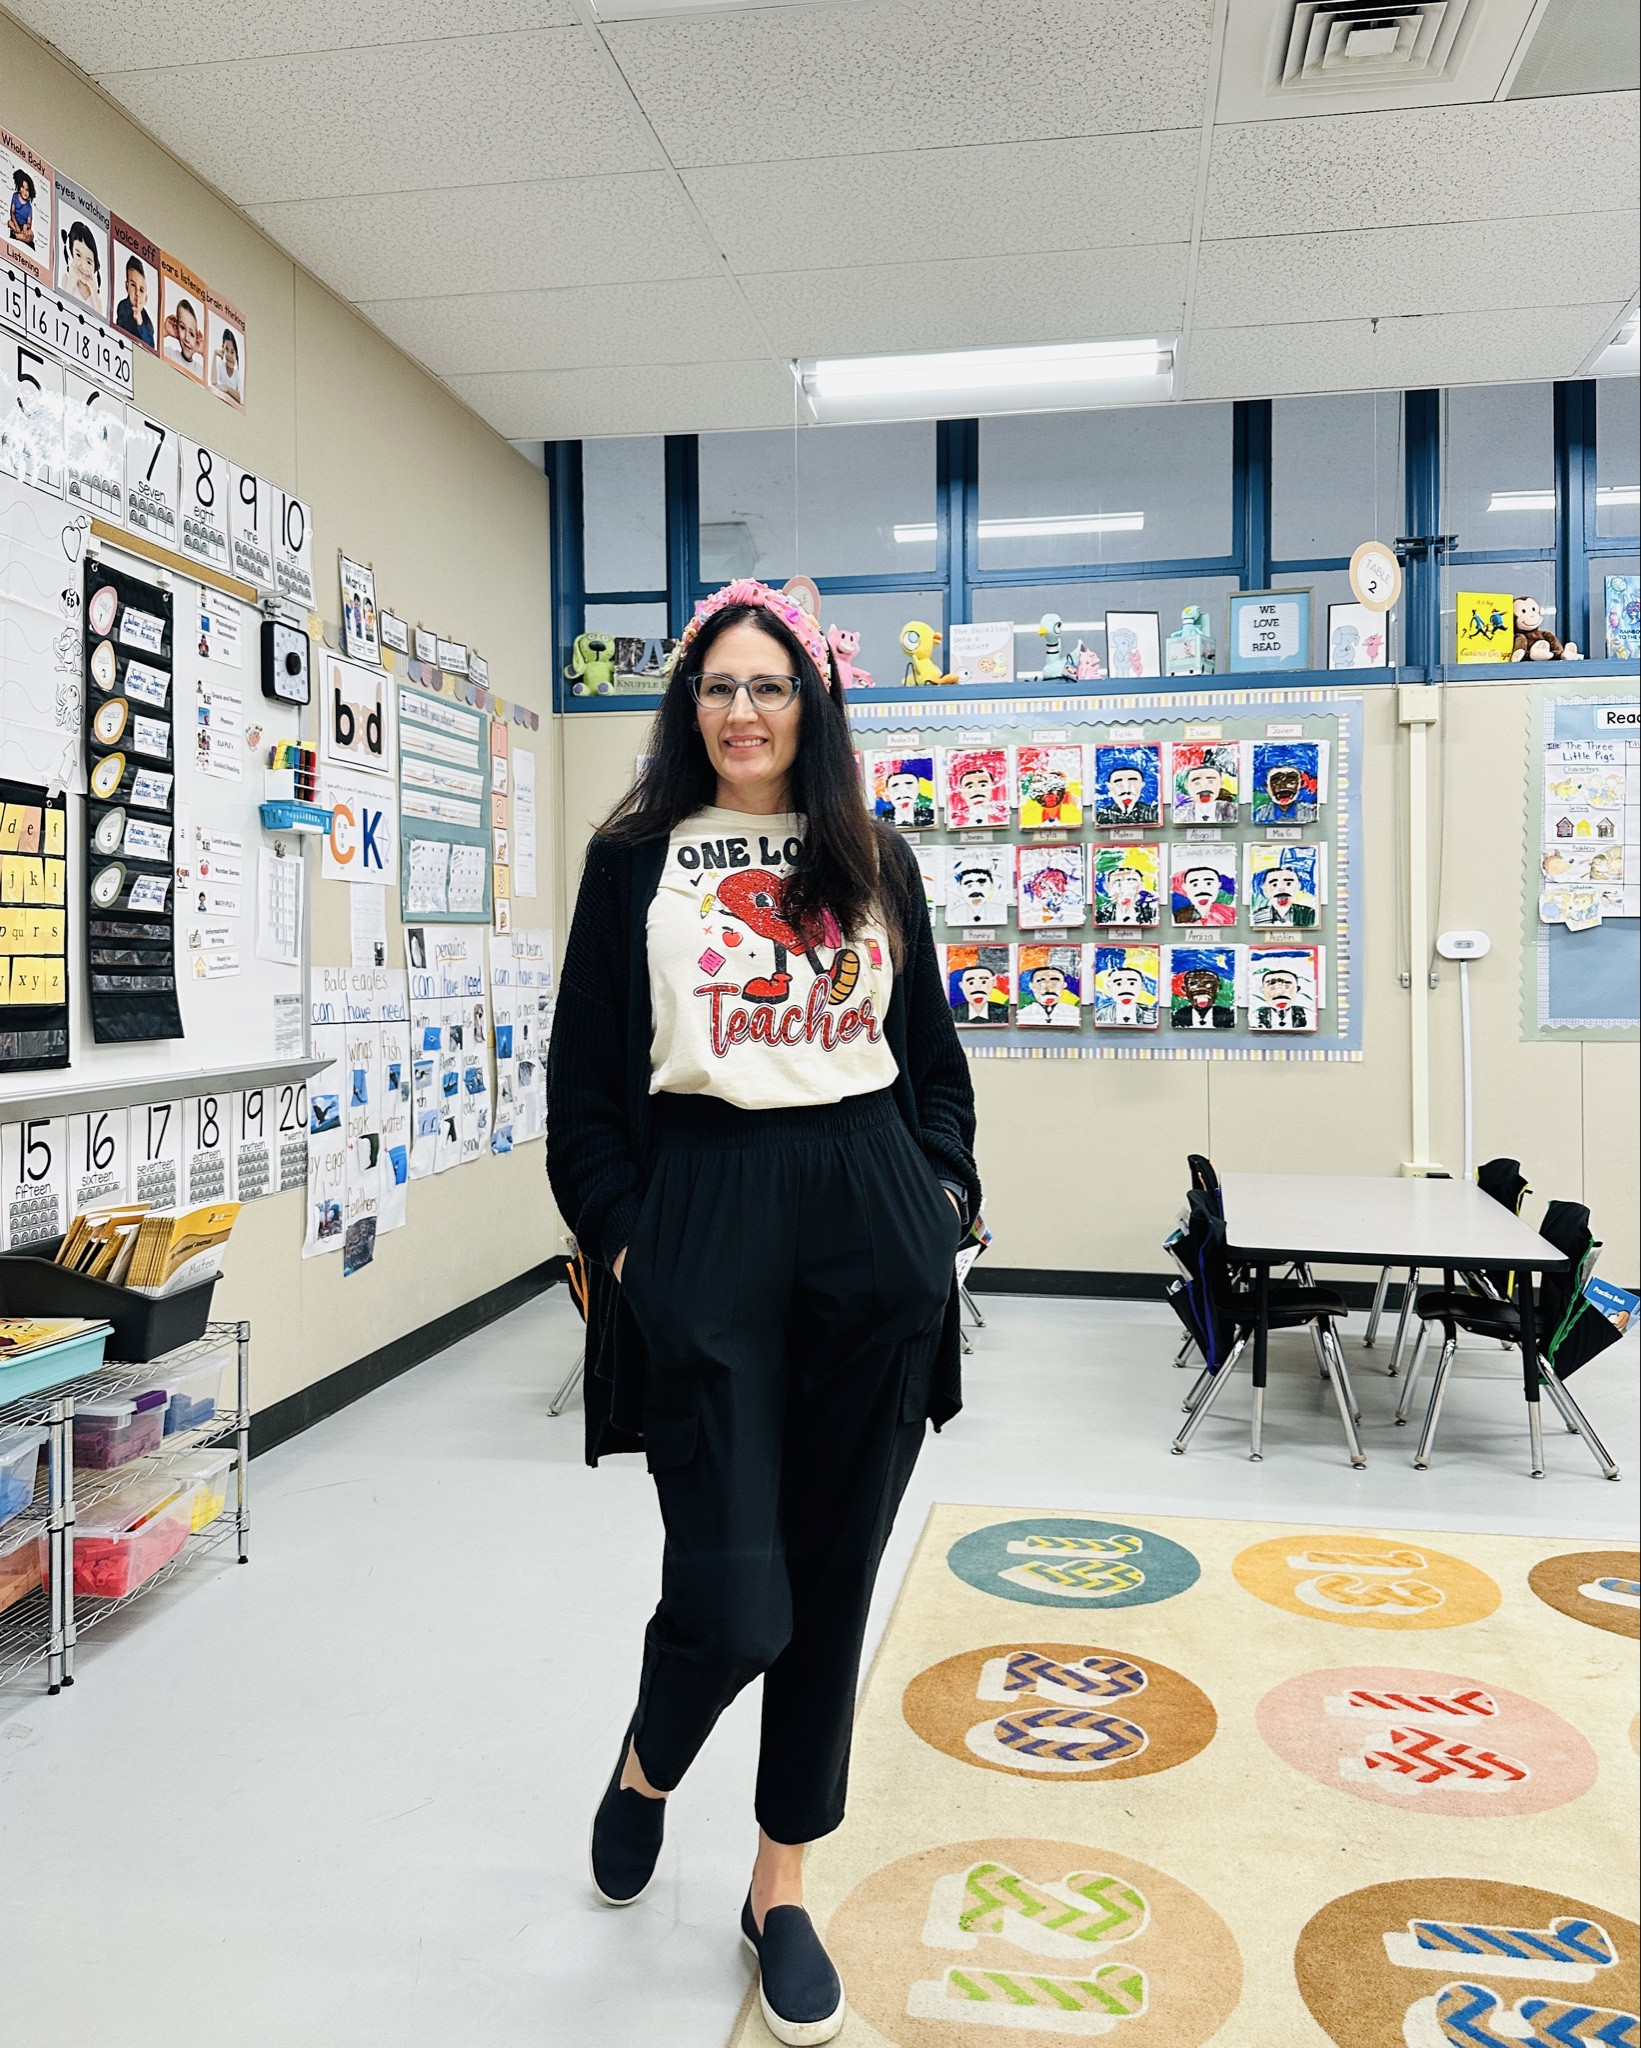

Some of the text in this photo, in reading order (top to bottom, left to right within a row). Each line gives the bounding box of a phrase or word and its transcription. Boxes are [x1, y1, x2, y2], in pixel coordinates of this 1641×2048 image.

[1, 131, 46, 176] Whole Body
[55, 179, 111, 230] eyes watching
[114, 226, 157, 263] voice off
[6, 244, 40, 277] Listening
[161, 260, 206, 302] ears listening
[206, 290, 246, 331] brain thinking
[5, 286, 130, 383] 15 16 17 18 19 20
[144, 420, 166, 482] 7
[196, 447, 215, 508] 8
[138, 480, 166, 502] seven
[239, 473, 257, 531] 9
[282, 493, 305, 553] 10
[243, 528, 259, 546] nine
[286, 549, 300, 565] ten
[1366, 558, 1391, 585] TABLE
[1367, 580, 1378, 594] 2
[1259, 605, 1276, 614] WE
[971, 625, 1009, 634] Duckling
[1253, 618, 1280, 628] LOVE
[1260, 632, 1276, 641] TO
[1252, 642, 1281, 652] READ
[102, 668, 107, 678] 2
[616, 678, 660, 690] KNUFFLE
[401, 694, 407, 711] I
[103, 711, 121, 719] TABLE
[107, 722, 112, 732] 3
[1114, 730, 1133, 738] Faith
[1188, 728, 1212, 737] Isaac
[1567, 741, 1614, 751] The Three
[1563, 751, 1615, 763] Little Pigs
[102, 777, 108, 786] 4
[495, 800, 504, 824] 2
[7, 819, 58, 838] d e f
[107, 832, 112, 842] 5
[1113, 830, 1134, 838] Mateo
[1190, 829, 1214, 840] Abigail
[1272, 829, 1284, 837] Mia
[677, 836, 805, 870] ONE LO
[10, 871, 15, 888] j
[30, 871, 38, 886] k
[498, 870, 506, 894] 3
[103, 888, 108, 897] 6
[12, 926, 24, 940] qu
[33, 926, 39, 938] r
[51, 926, 58, 938] s
[1269, 930, 1295, 941] Austin
[434, 937, 467, 972] penguins
[18, 975, 27, 986] x
[31, 975, 40, 990] y
[52, 975, 58, 987] z
[324, 968, 388, 1002] Bald eagles
[412, 965, 482, 999] can have need
[495, 967, 510, 985] can
[312, 992, 406, 1023] can have need
[693, 973, 882, 1058] Teacher
[348, 1037, 373, 1074] wings
[381, 1030, 403, 1061] fish
[242, 1089, 264, 1140] 19
[279, 1085, 308, 1132] 20
[197, 1097, 220, 1150] 18
[347, 1103, 406, 1138] beak water
[86, 1112, 115, 1172] 16
[147, 1103, 172, 1161] 17
[284, 1131, 306, 1142] twenty
[20, 1120, 52, 1184] 15
[240, 1139, 266, 1151] nineteen
[192, 1148, 221, 1163] eighteen
[136, 1158, 175, 1174] seventeen
[325, 1149, 345, 1187] eggs
[81, 1171, 114, 1187] sixteen
[15, 1182, 52, 1197] fifteen
[344, 1186, 378, 1221] feathers
[188, 1257, 215, 1277] Mateo
[1593, 1286, 1626, 1305] Practice Book
[1008, 1533, 1146, 1595] 19
[1300, 1548, 1447, 1612] 13
[985, 1650, 1149, 1767] 20
[1338, 1687, 1530, 1788] 14
[935, 1861, 1152, 2025] 21
